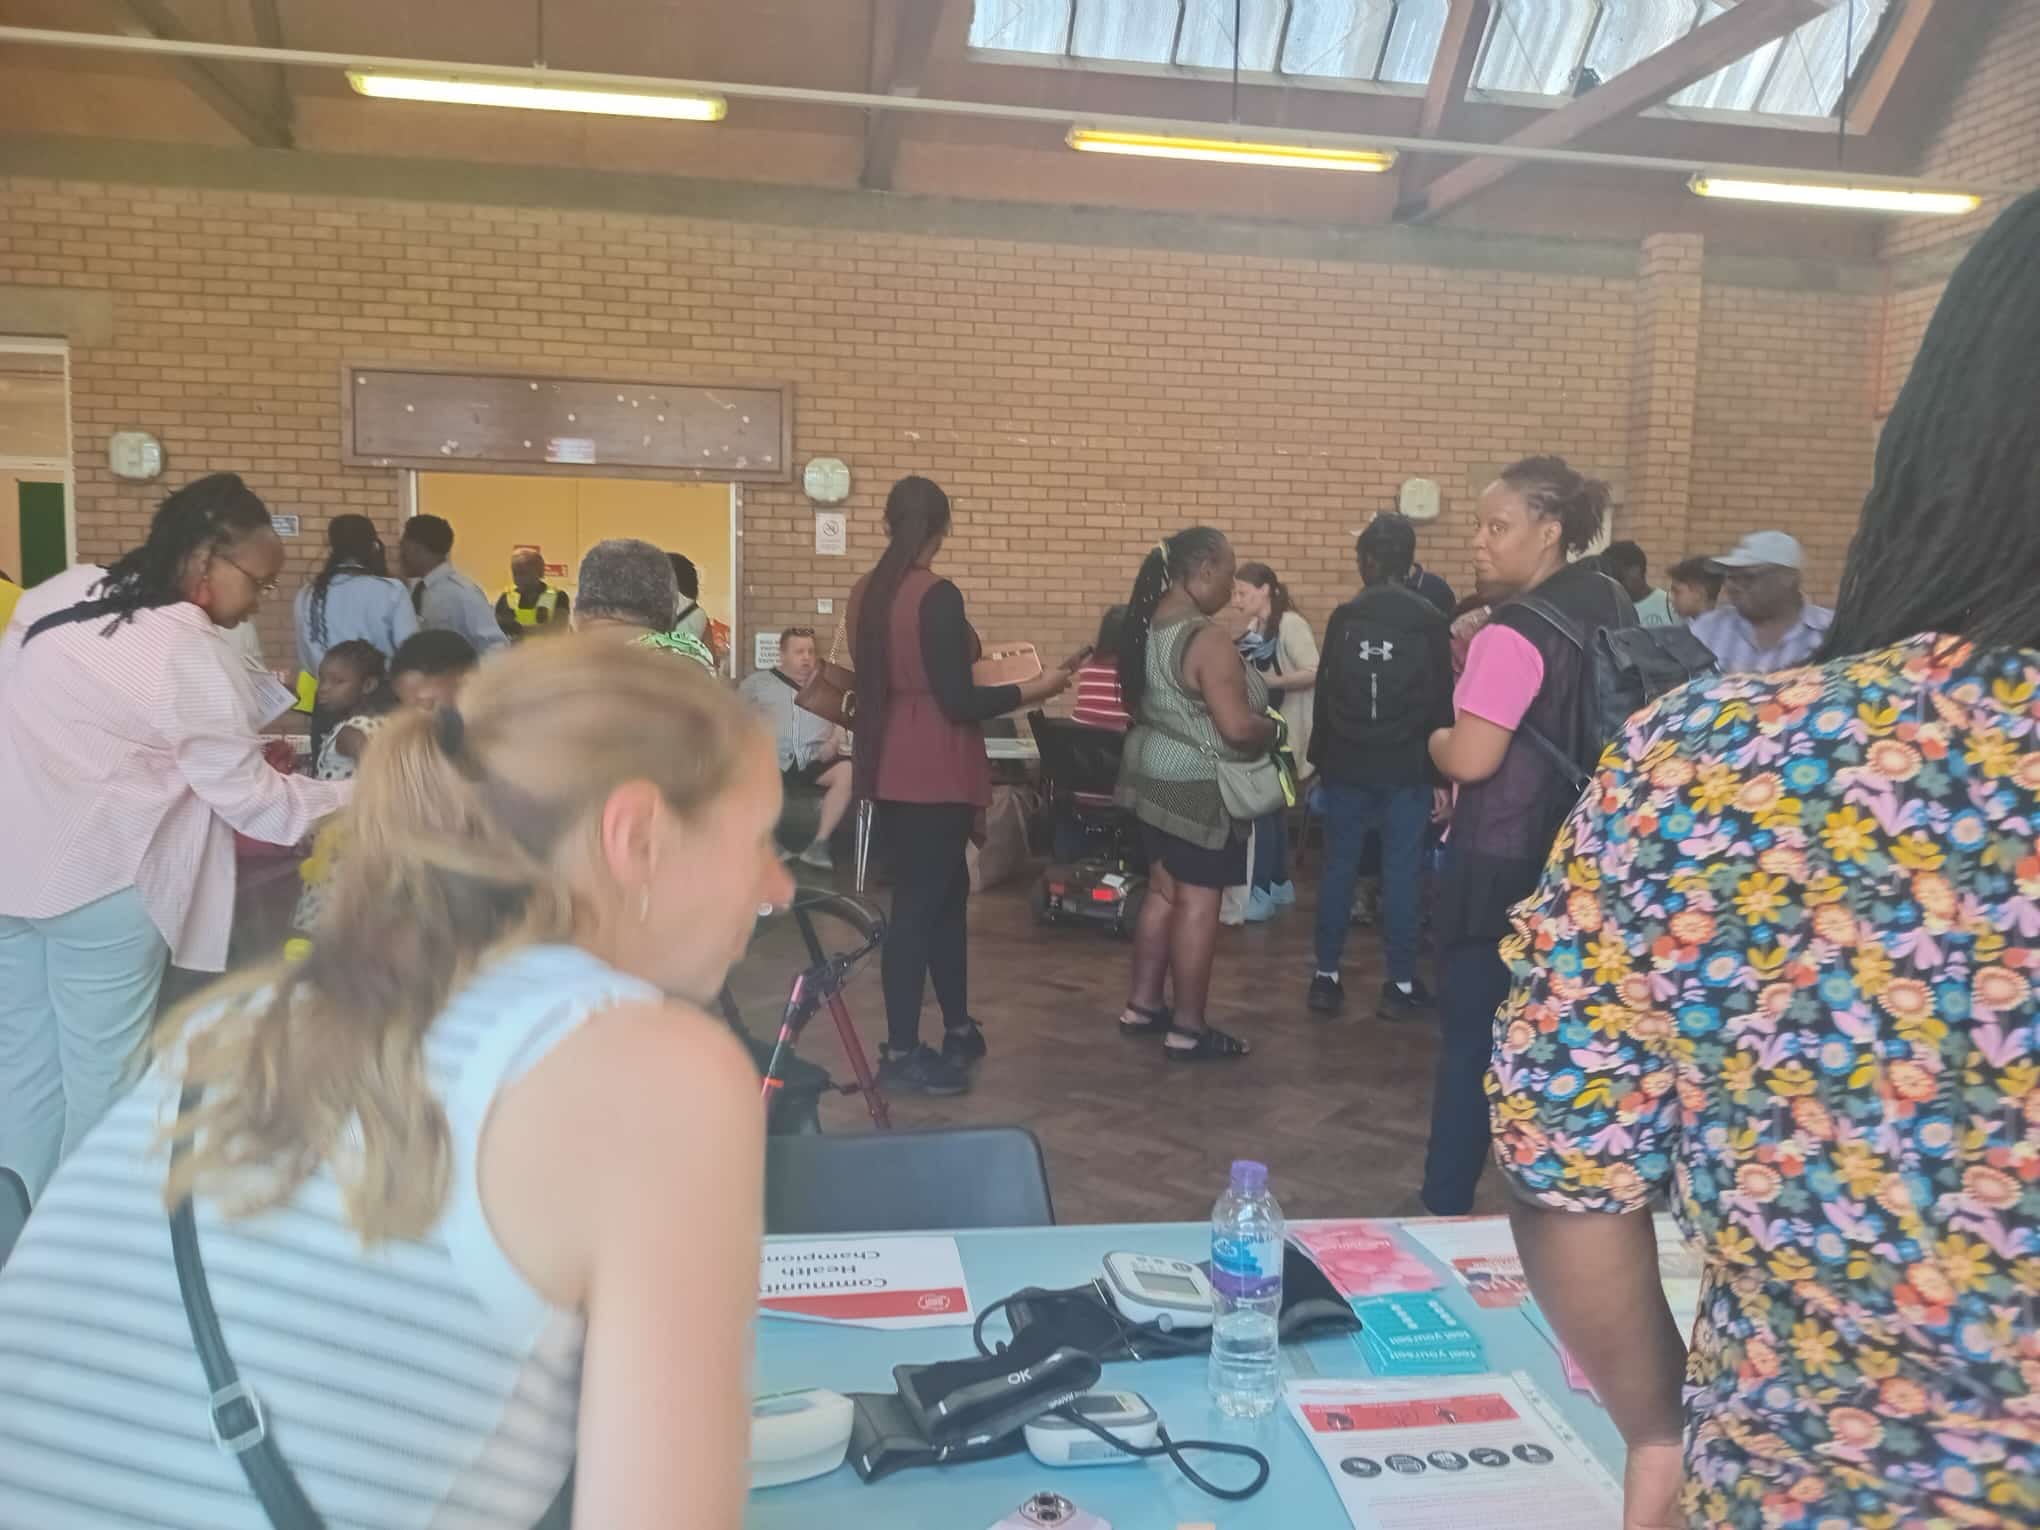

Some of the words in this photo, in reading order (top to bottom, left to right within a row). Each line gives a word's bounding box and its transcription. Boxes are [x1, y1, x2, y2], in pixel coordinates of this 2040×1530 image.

[781, 1265, 857, 1277] Health
[759, 1278, 887, 1295] Communit
[1007, 1367, 1033, 1385] OK
